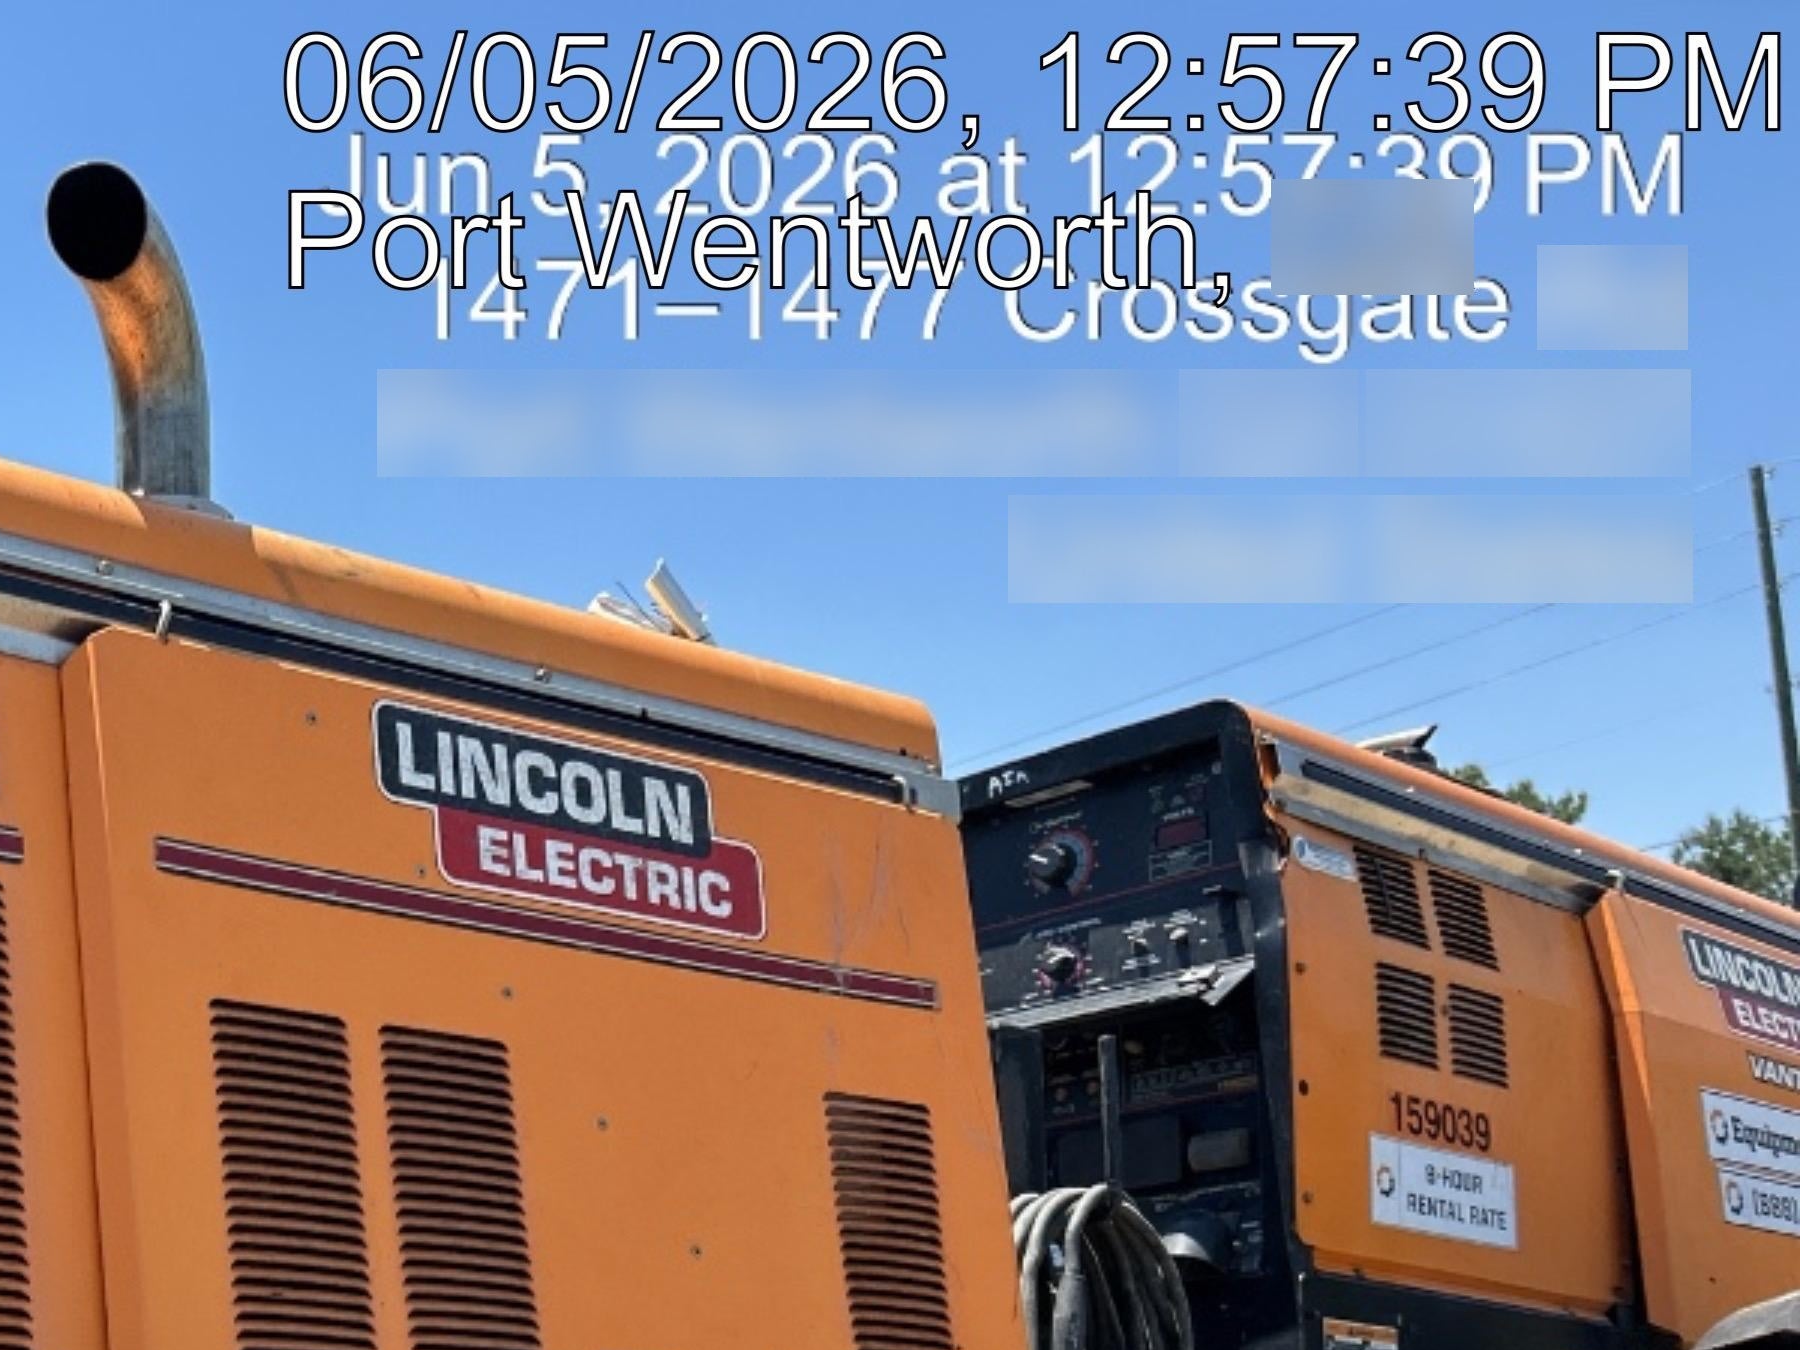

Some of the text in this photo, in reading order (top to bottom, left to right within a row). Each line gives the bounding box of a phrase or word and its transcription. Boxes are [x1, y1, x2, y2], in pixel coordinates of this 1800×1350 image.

[395, 722, 694, 846] LINCOLN
[476, 824, 733, 920] ELECTRIC
[1389, 1091, 1490, 1152] 159039
[1406, 1192, 1508, 1231] RENTAL RATE
